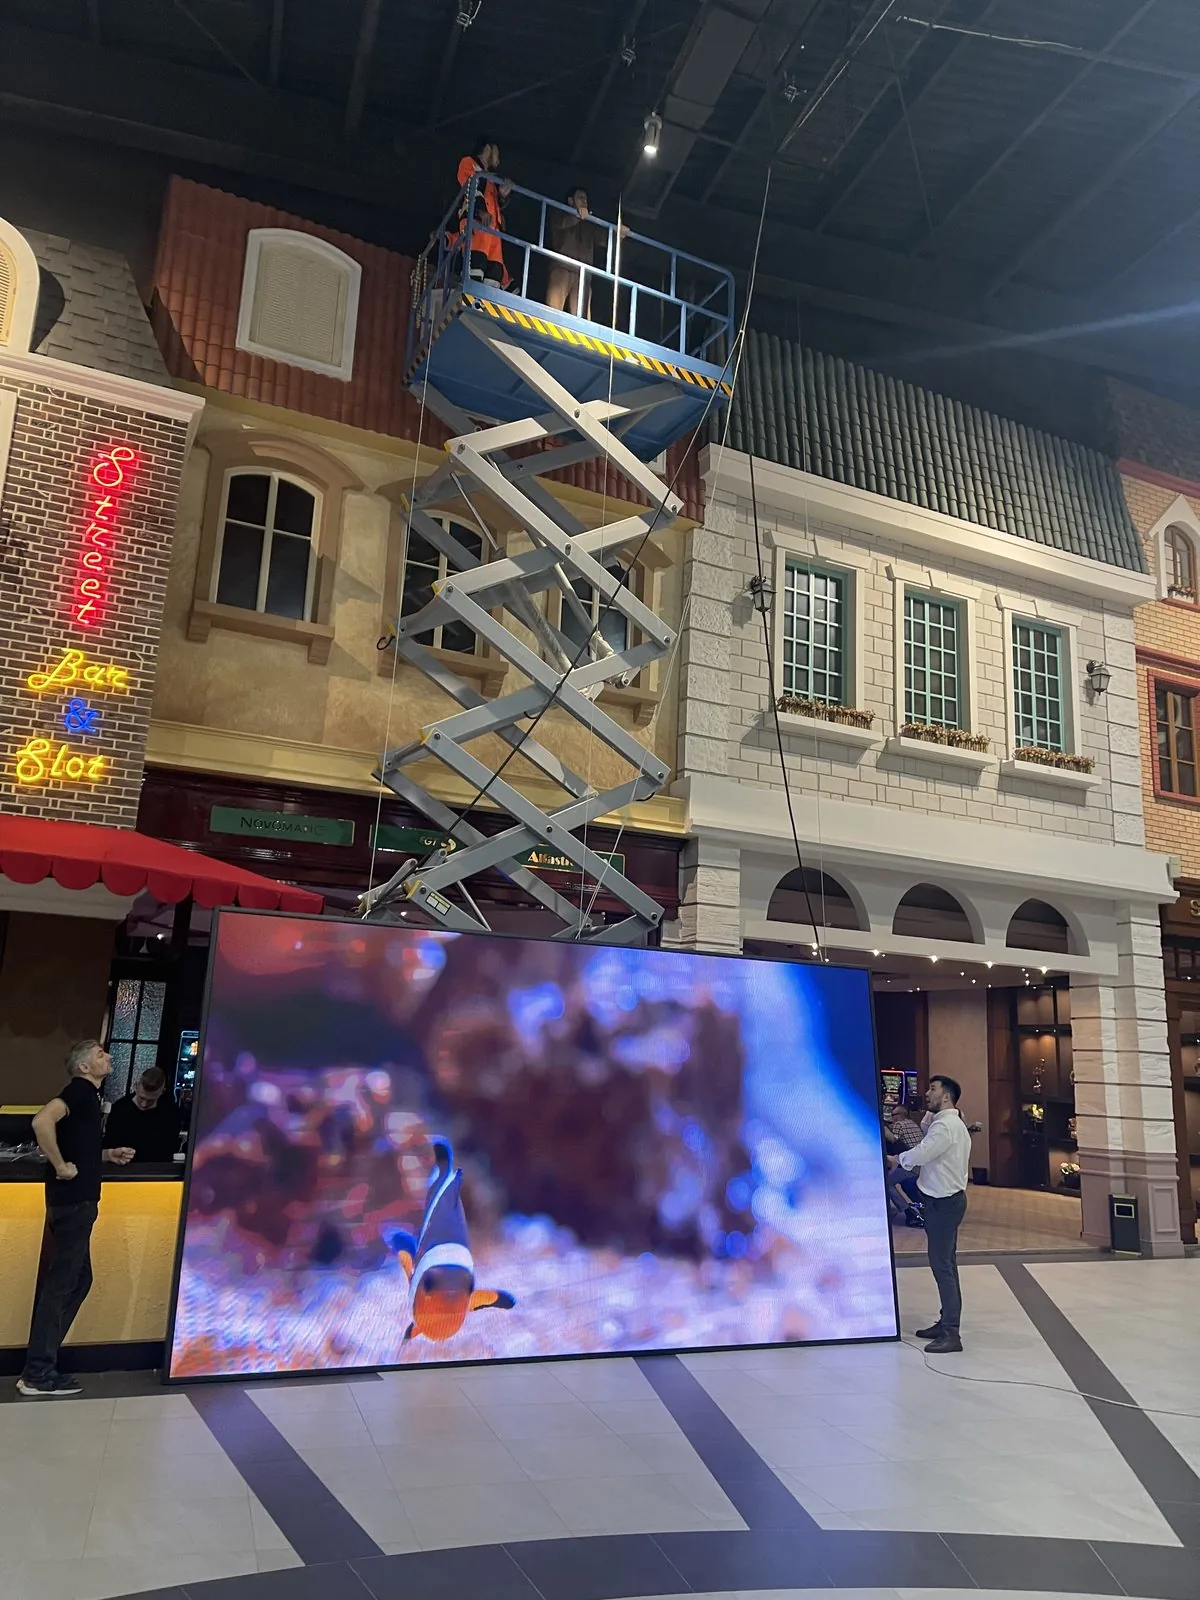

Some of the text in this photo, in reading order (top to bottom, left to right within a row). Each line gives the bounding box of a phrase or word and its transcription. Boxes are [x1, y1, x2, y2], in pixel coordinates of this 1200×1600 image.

[76, 446, 135, 625] Street
[27, 648, 128, 689] Bar
[65, 697, 97, 733] &
[16, 739, 104, 782] Slot
